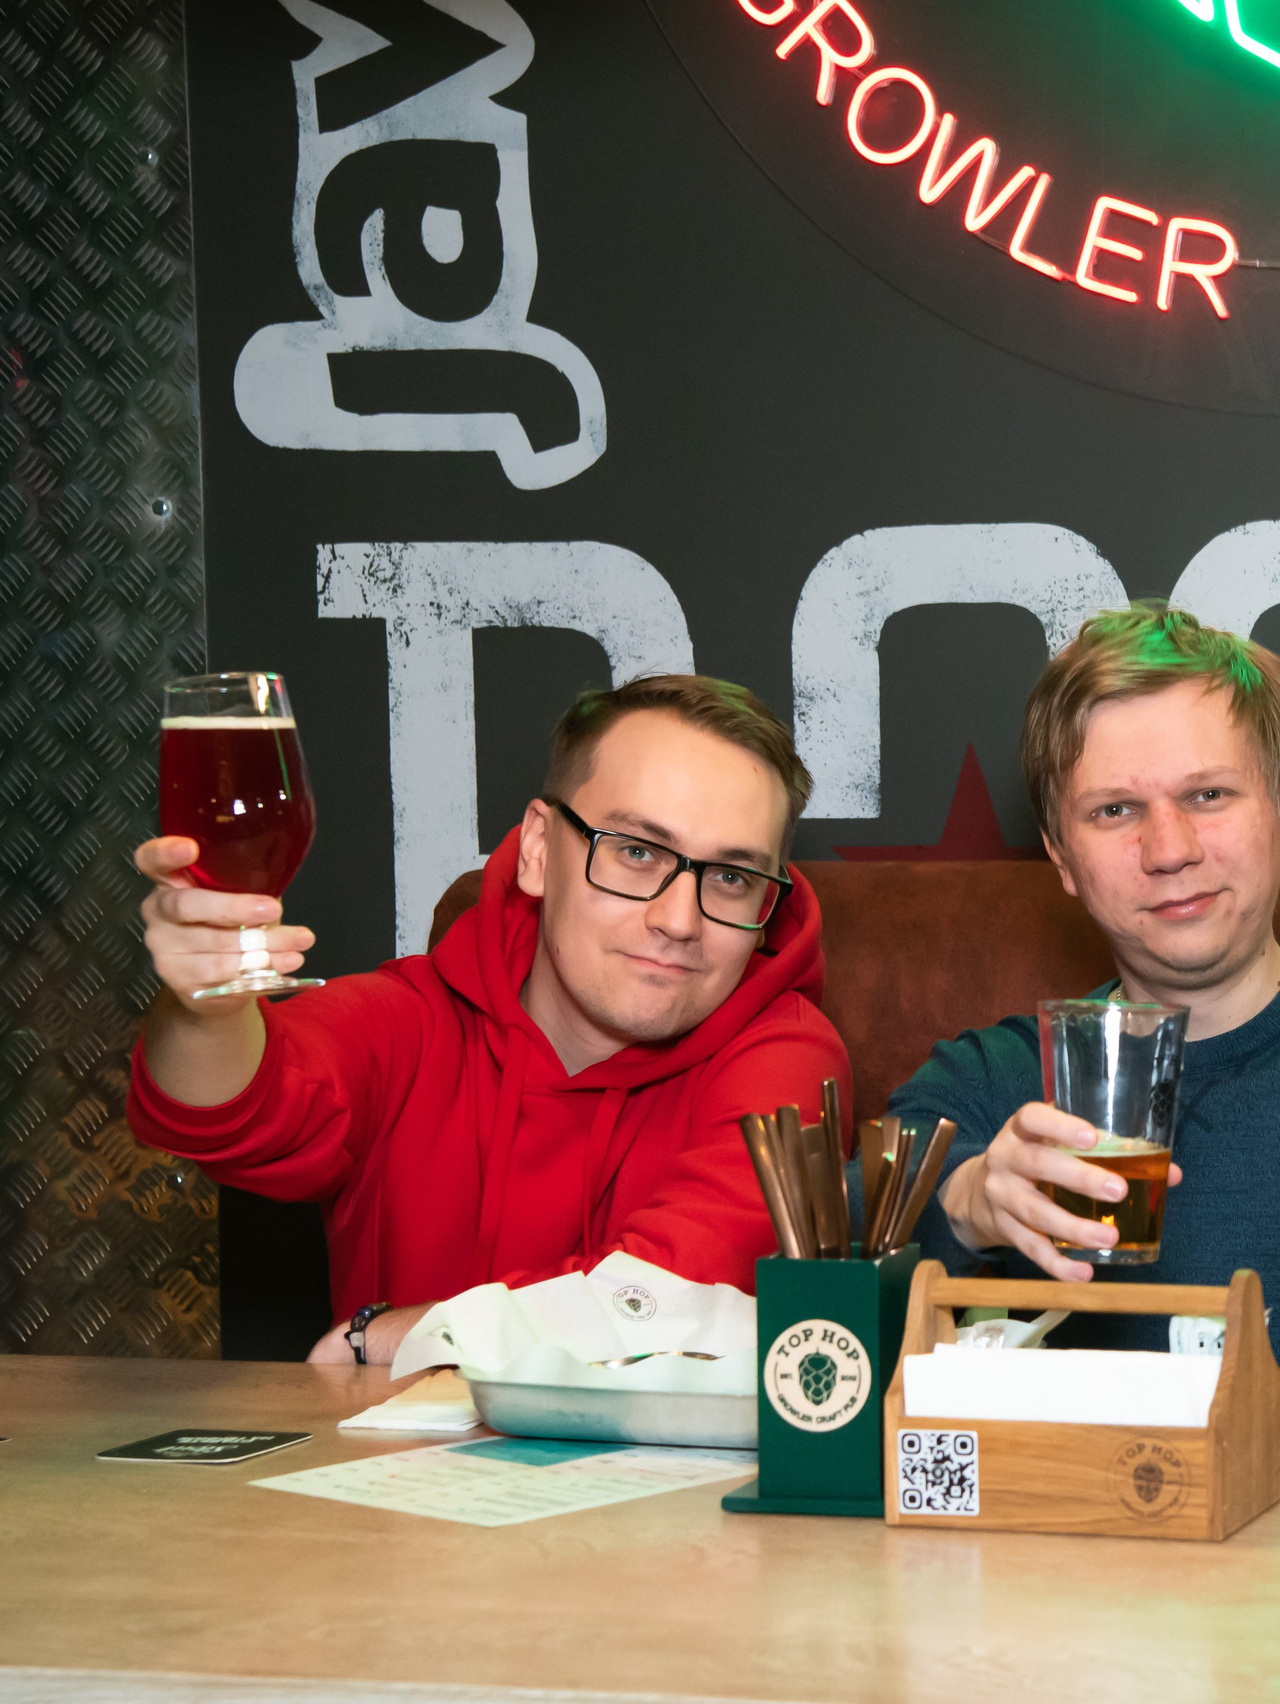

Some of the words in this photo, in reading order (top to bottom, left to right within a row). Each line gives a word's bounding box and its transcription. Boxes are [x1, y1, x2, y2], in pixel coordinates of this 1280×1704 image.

[777, 1328, 814, 1358] TOP
[821, 1328, 860, 1361] HOP
[1117, 1442, 1146, 1467] TOP
